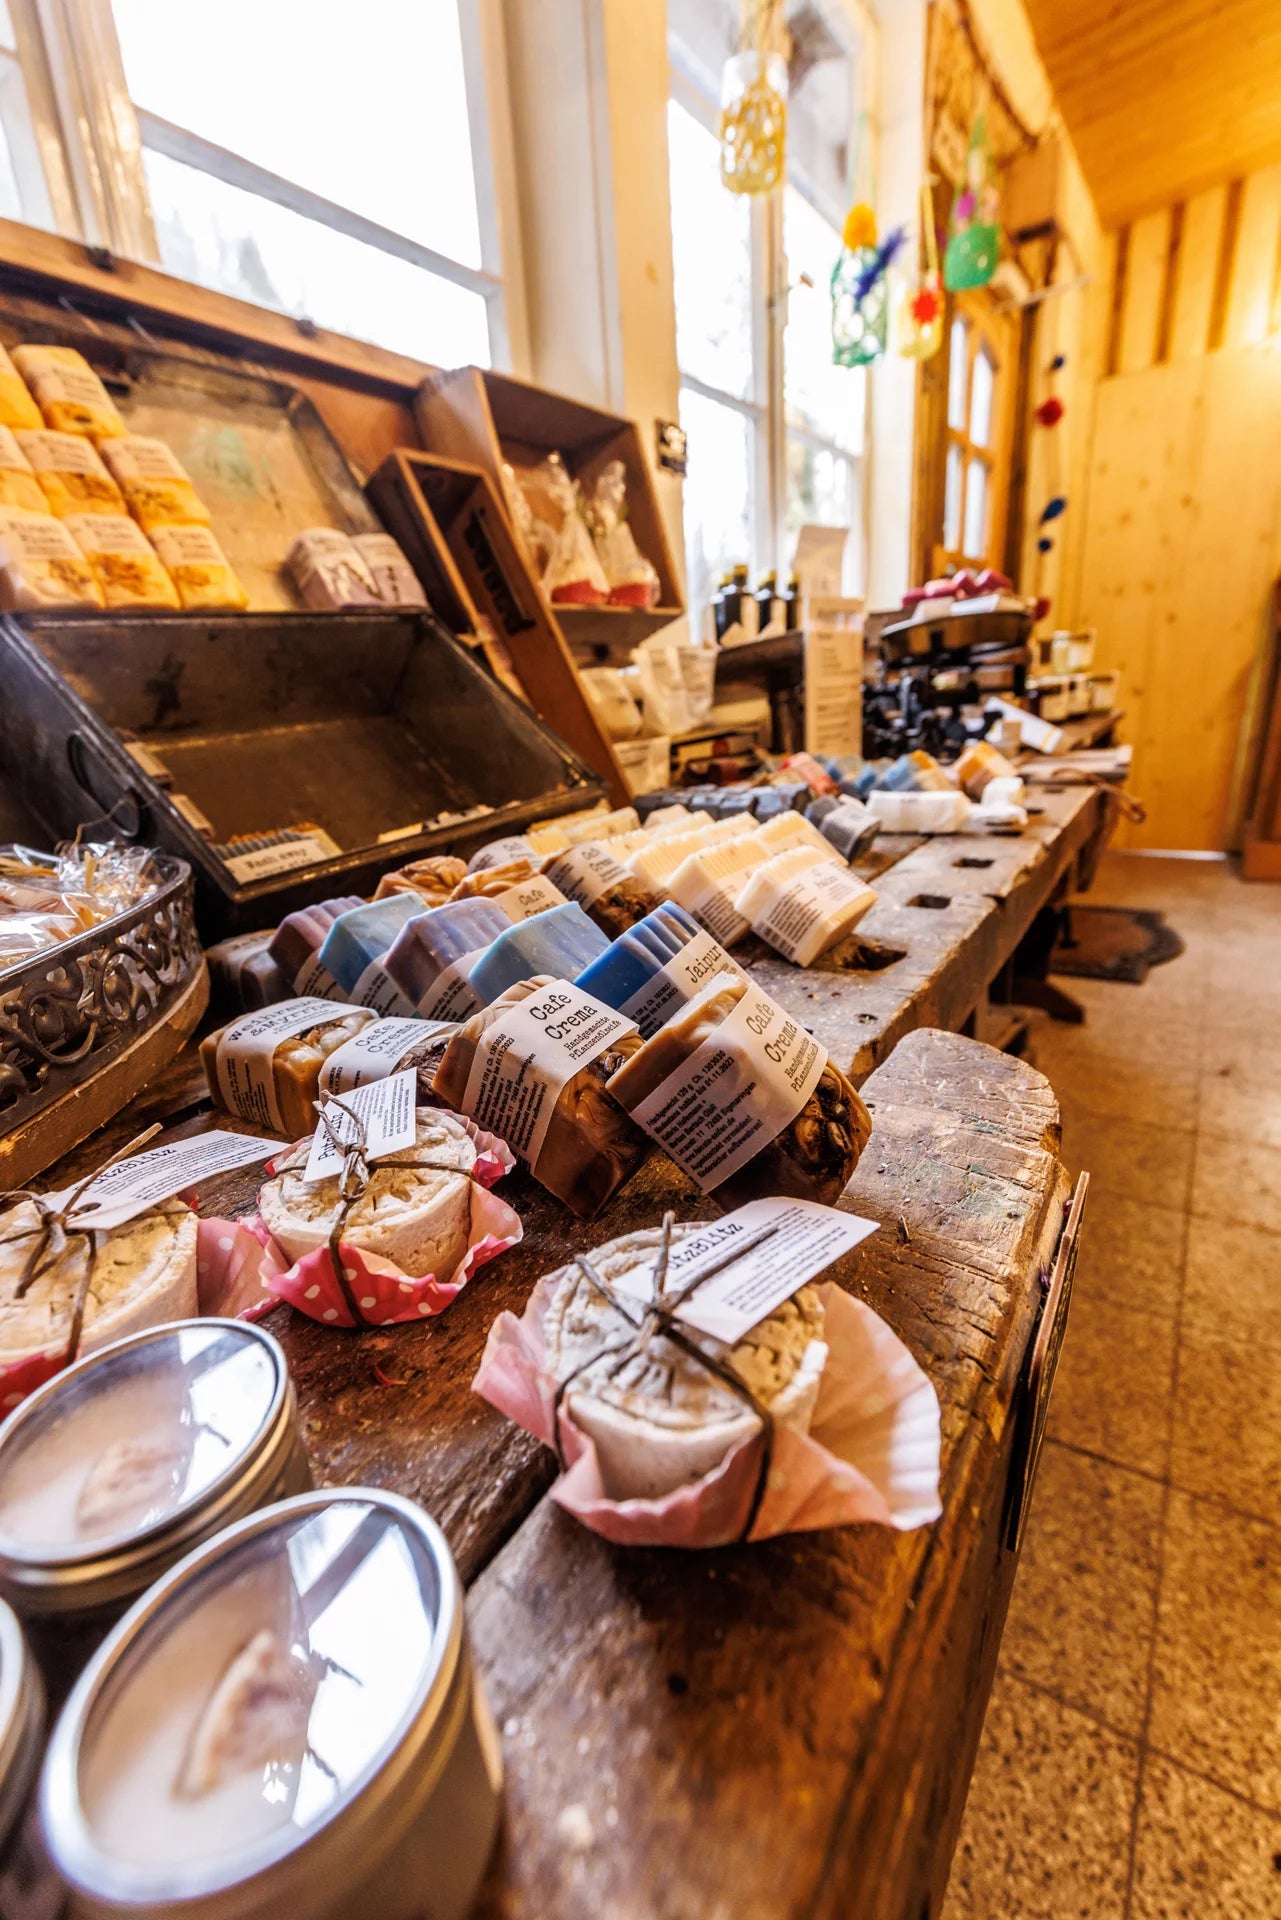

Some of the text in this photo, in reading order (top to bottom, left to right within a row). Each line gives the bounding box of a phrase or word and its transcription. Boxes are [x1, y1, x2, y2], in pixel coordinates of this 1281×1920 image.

[518, 889, 546, 906] Cafe
[685, 946, 722, 983] Jaipur
[530, 994, 572, 1020] Cafe
[545, 1005, 598, 1040] Crema
[746, 1003, 775, 1035] Cafe
[355, 1024, 395, 1048] Cafe
[367, 1022, 418, 1053] Crema
[564, 1016, 610, 1050] Handgemachte
[764, 1021, 798, 1063] Crema
[678, 1086, 689, 1098] 120
[696, 1085, 707, 1097] bis
[705, 1056, 735, 1087] 01.11.2023
[696, 1130, 705, 1138] 11
[720, 1082, 757, 1116] Sigmaringen
[648, 1222, 743, 1271] utzBlitz
